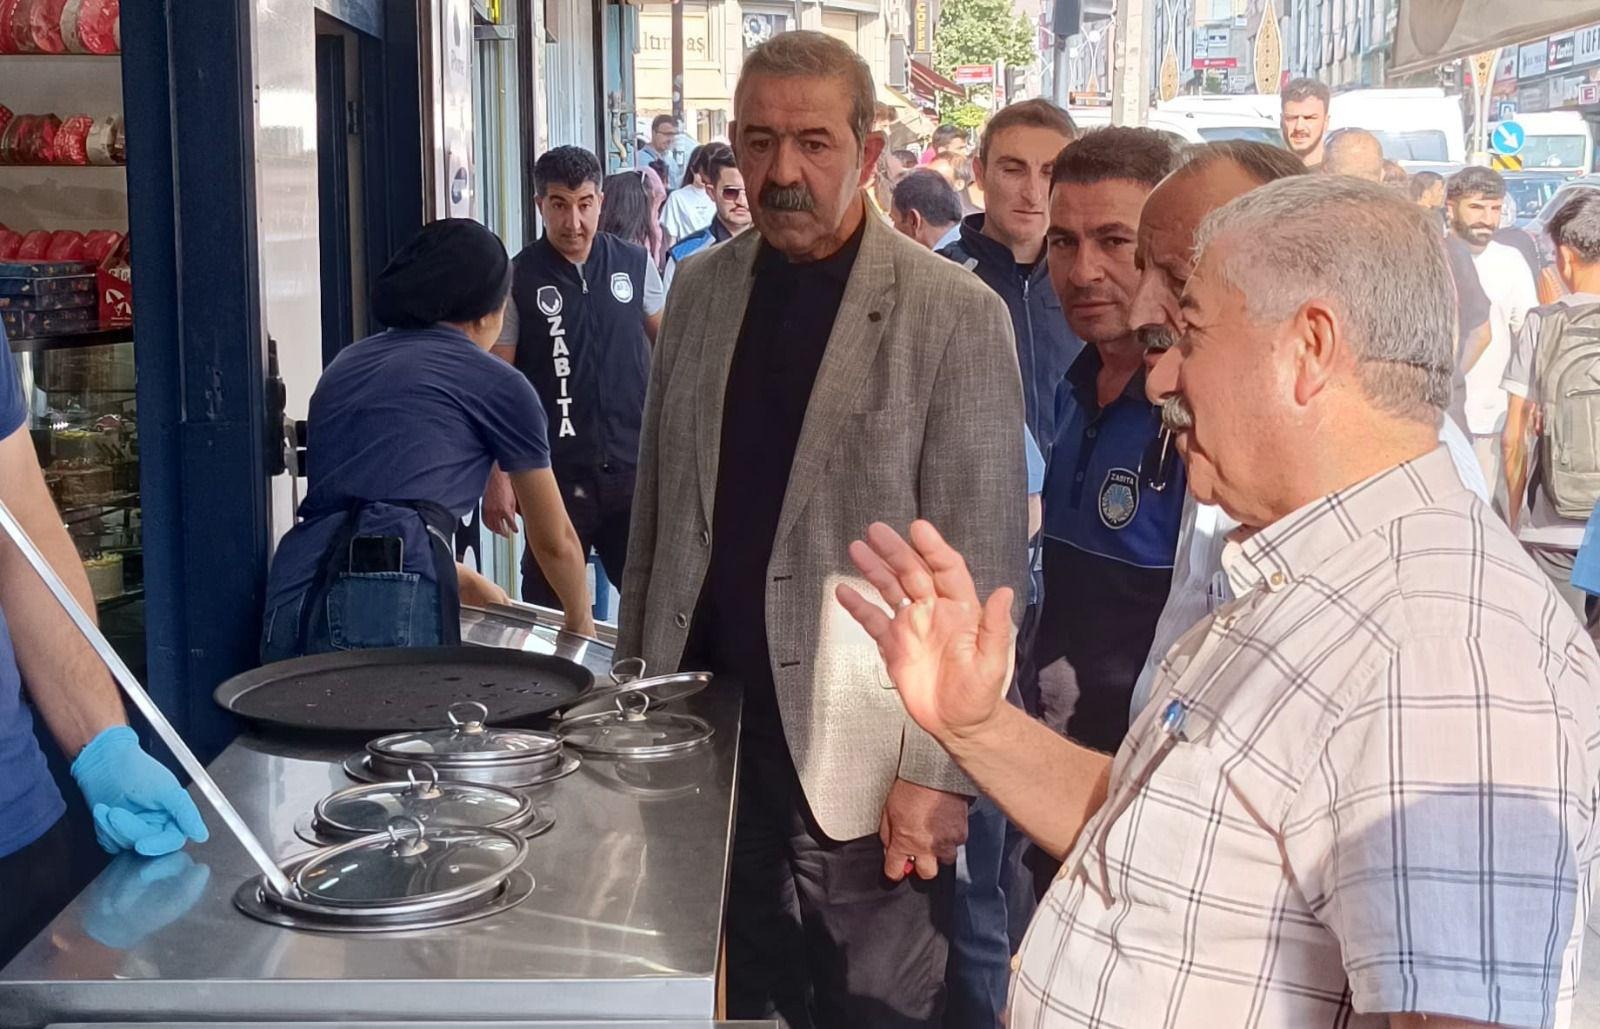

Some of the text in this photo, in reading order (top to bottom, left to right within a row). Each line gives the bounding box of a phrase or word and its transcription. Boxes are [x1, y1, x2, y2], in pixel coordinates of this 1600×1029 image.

[643, 32, 706, 54] ltınaş
[1584, 88, 1594, 100] E
[547, 315, 577, 438] ZABITA
[1111, 473, 1134, 484] ZABITA
